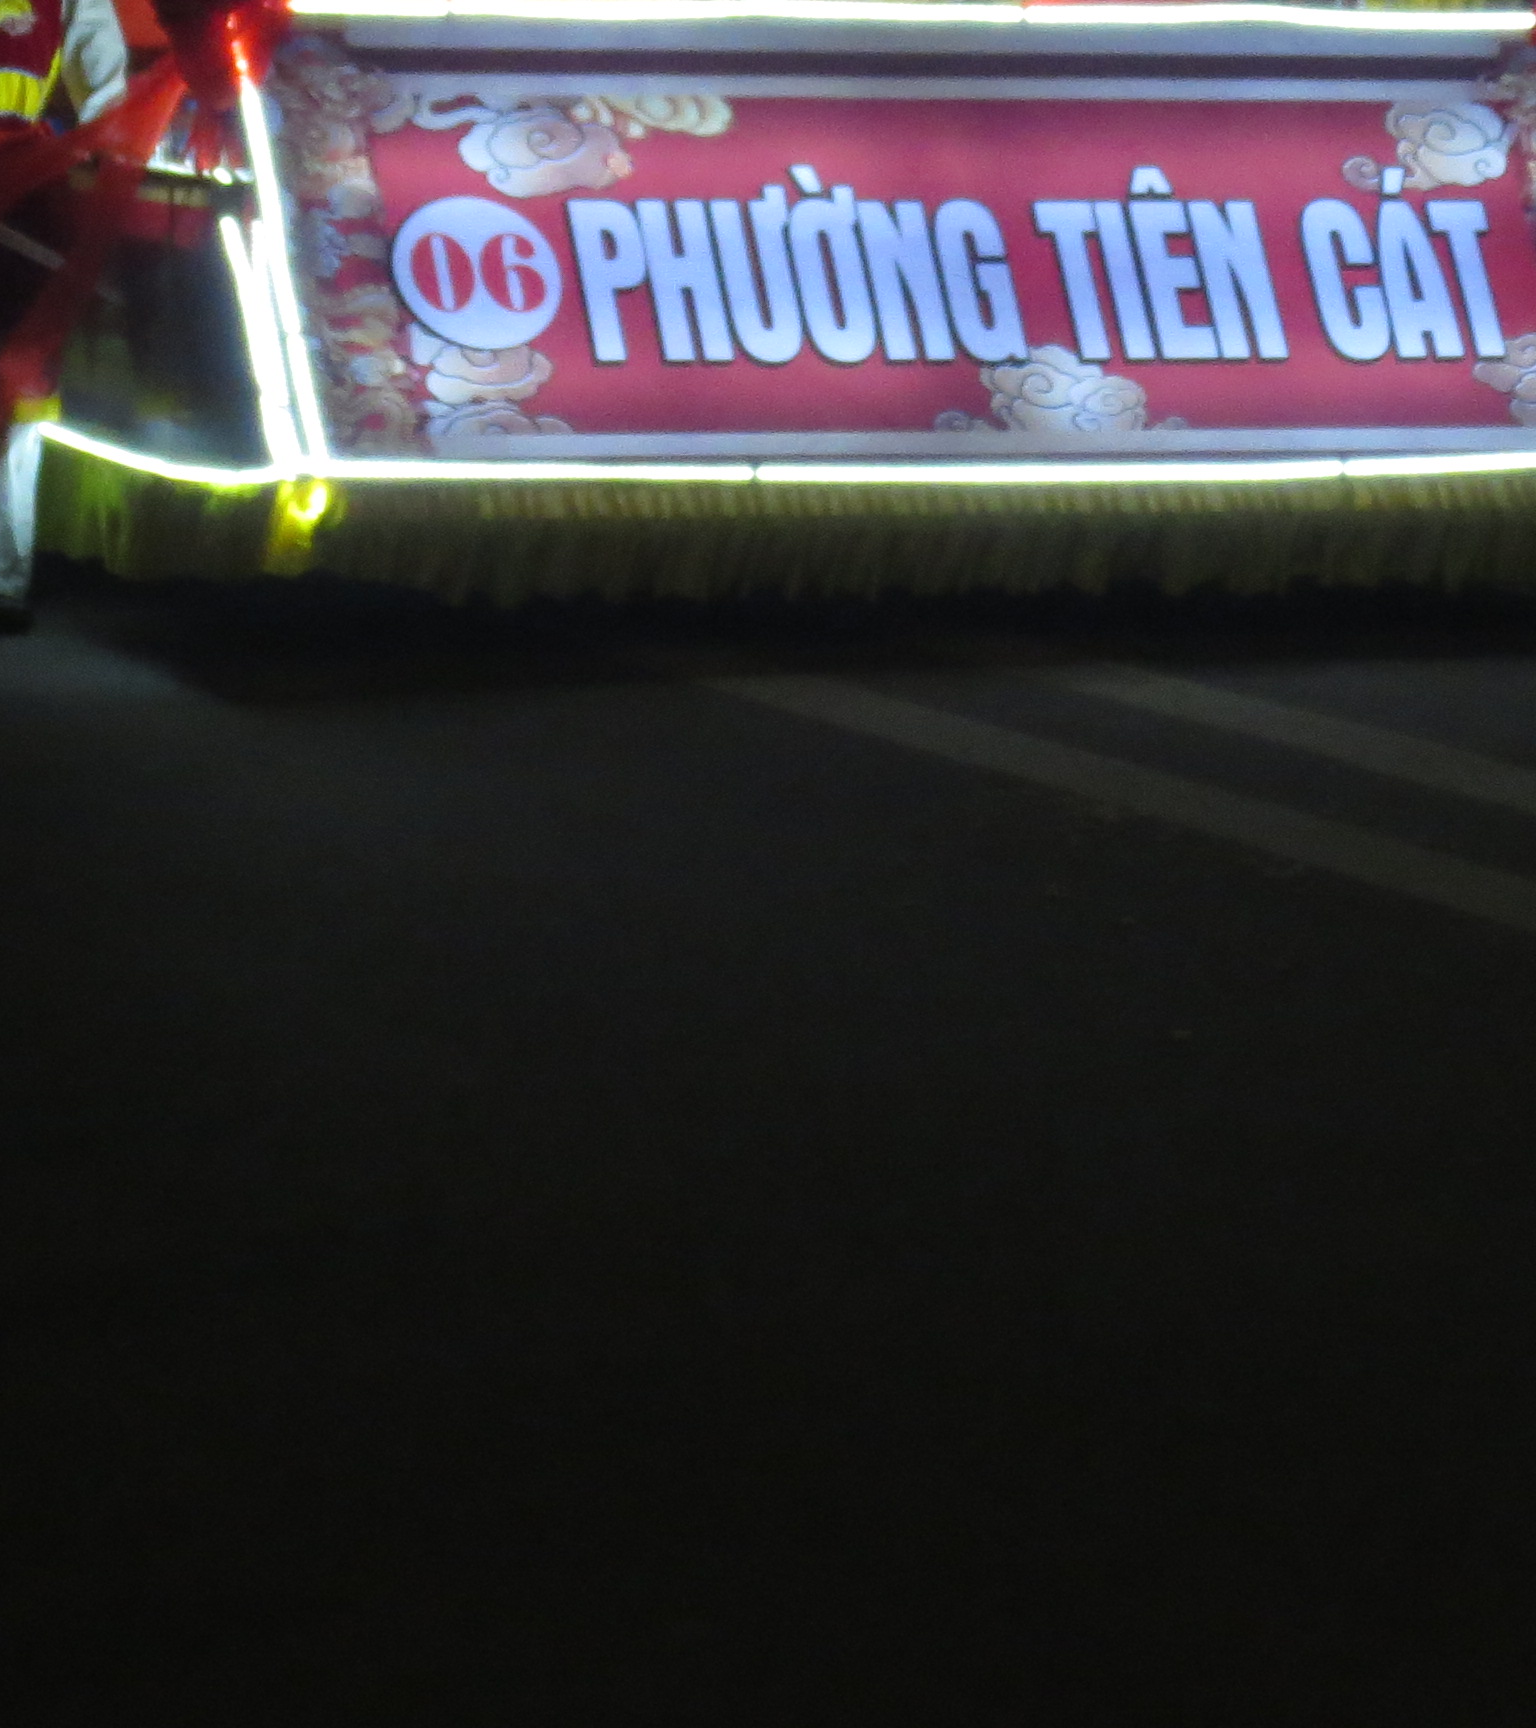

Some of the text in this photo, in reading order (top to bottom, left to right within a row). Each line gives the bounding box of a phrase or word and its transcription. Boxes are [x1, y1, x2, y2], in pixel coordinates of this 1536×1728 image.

[409, 163, 1507, 365] 06 PHƯỜNG TIÊN CÁT
